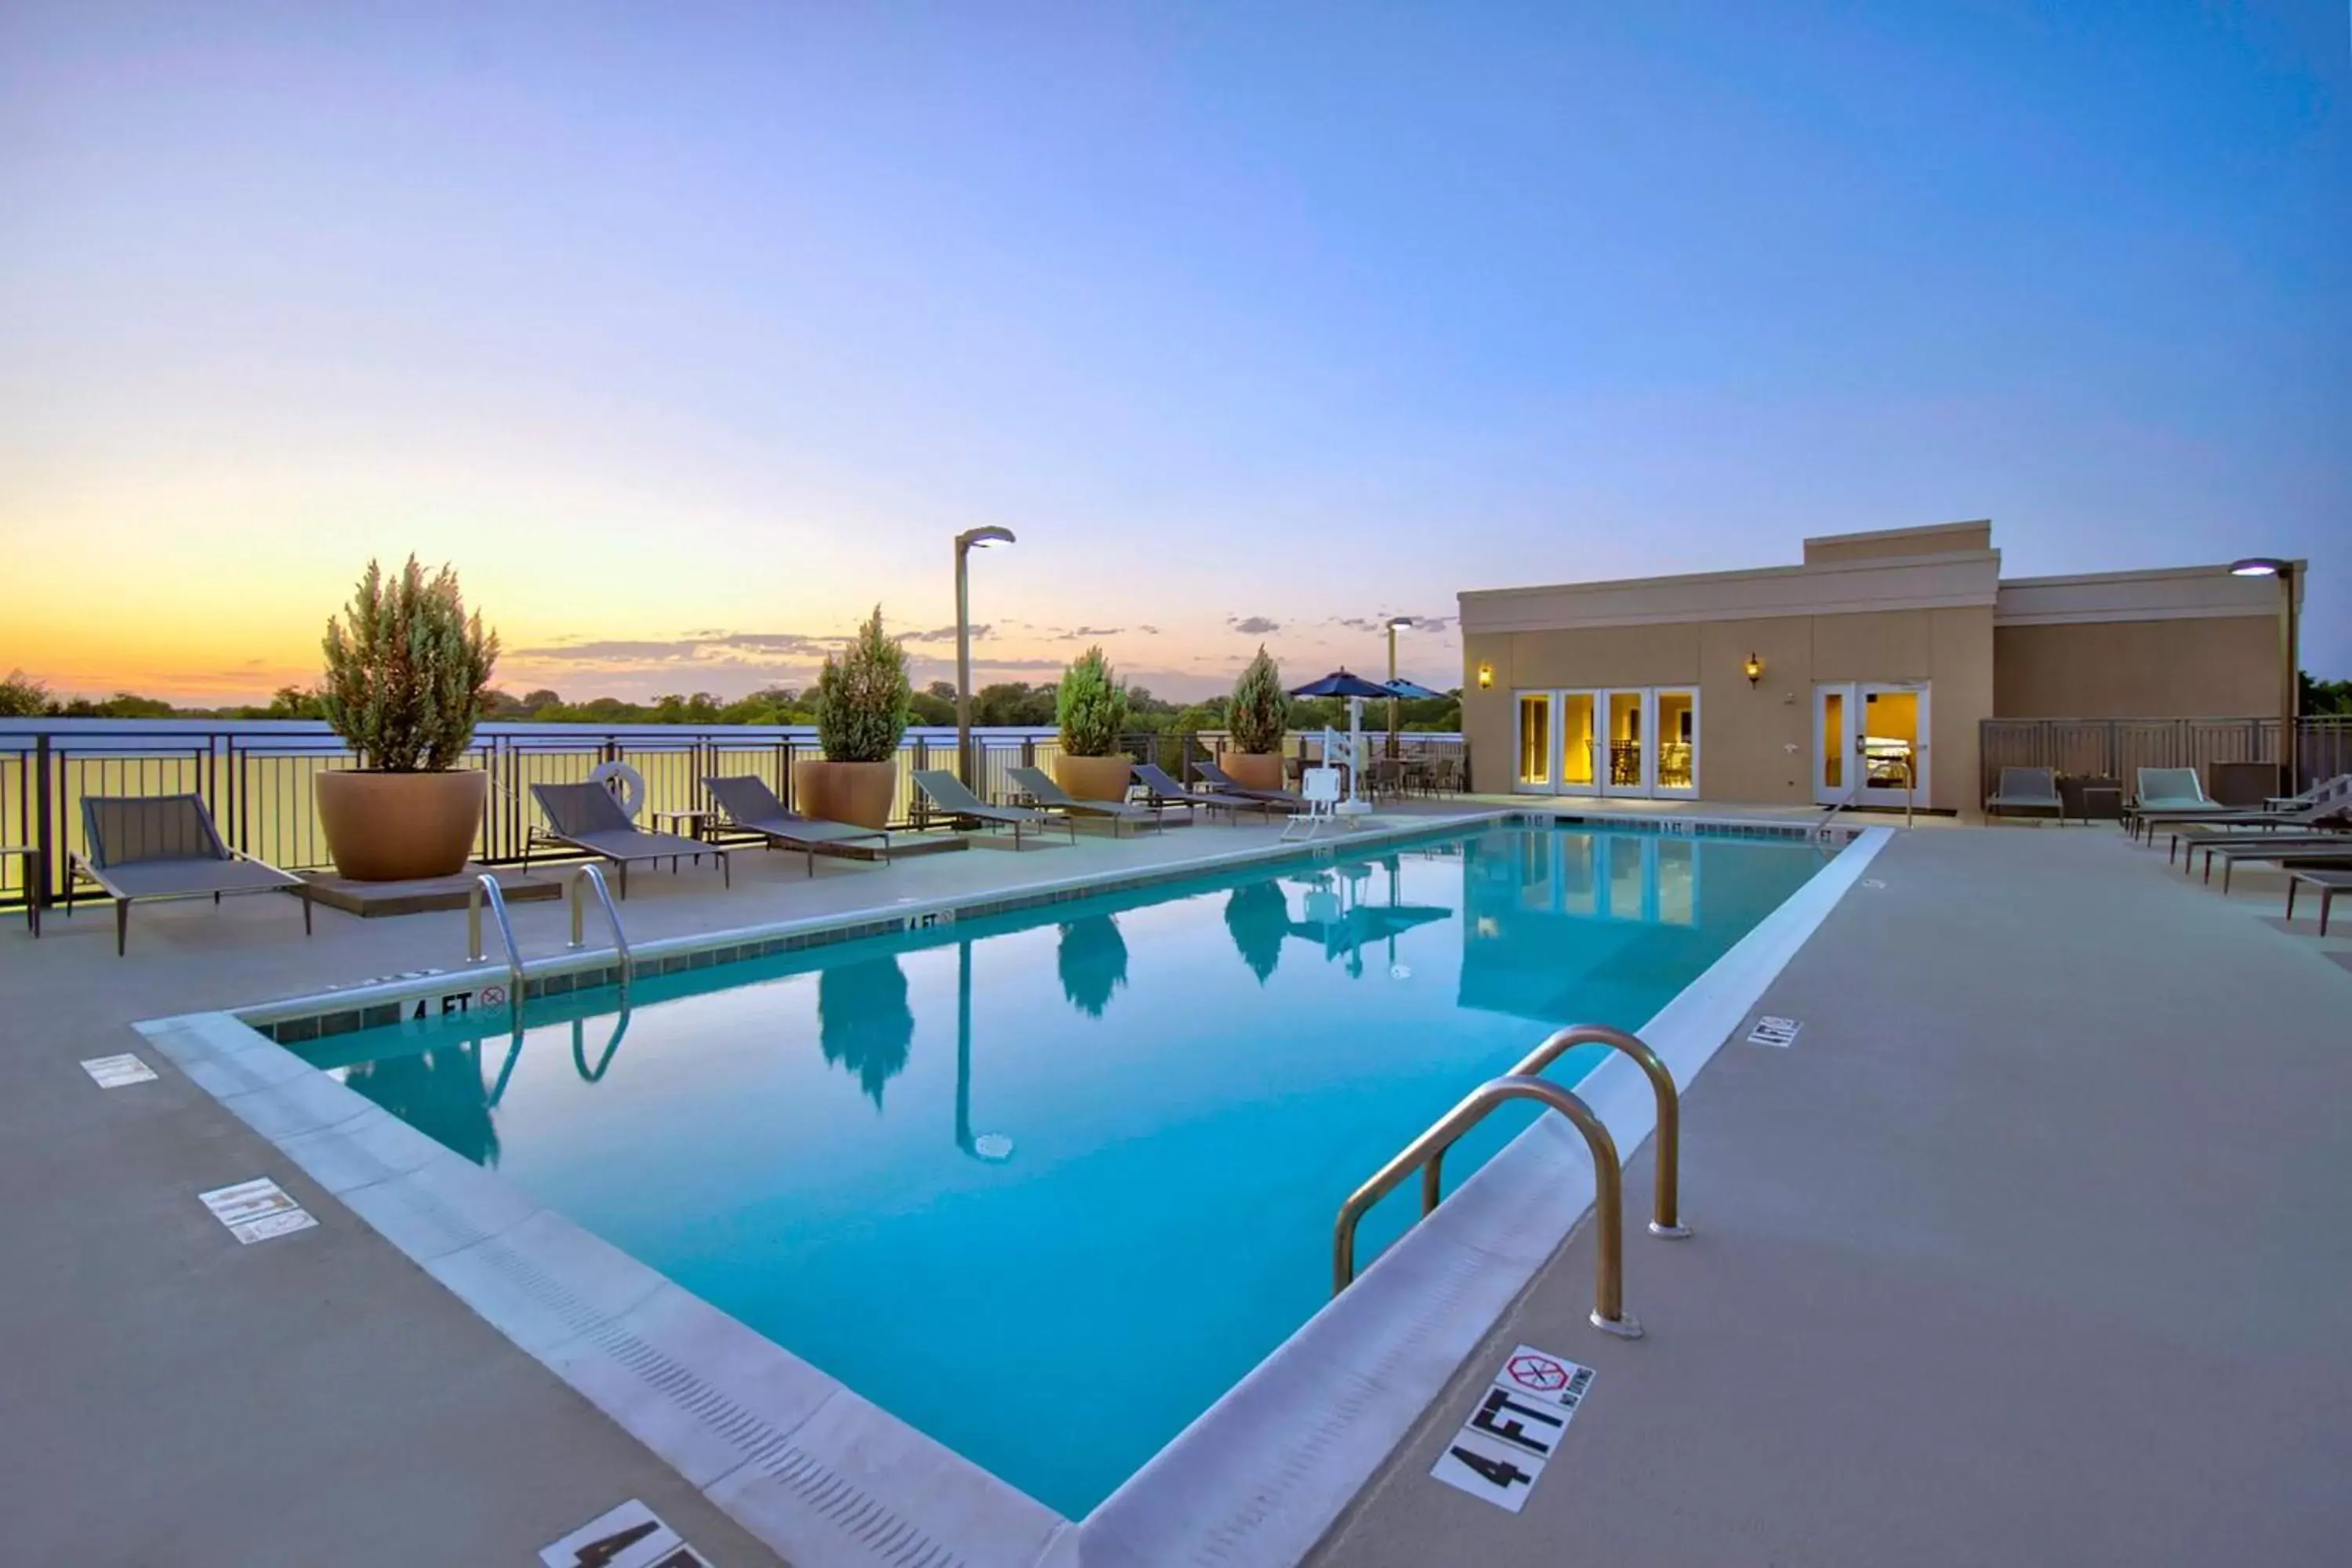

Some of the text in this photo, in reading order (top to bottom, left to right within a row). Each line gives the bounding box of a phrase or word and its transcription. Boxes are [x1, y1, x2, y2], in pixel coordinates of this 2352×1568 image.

[922, 913, 937, 927] FT
[413, 992, 472, 1019] 4 FT
[1559, 1367, 1593, 1407] NO DIVING
[1451, 1388, 1564, 1489] 4 FT
[571, 1520, 661, 1567] 4
